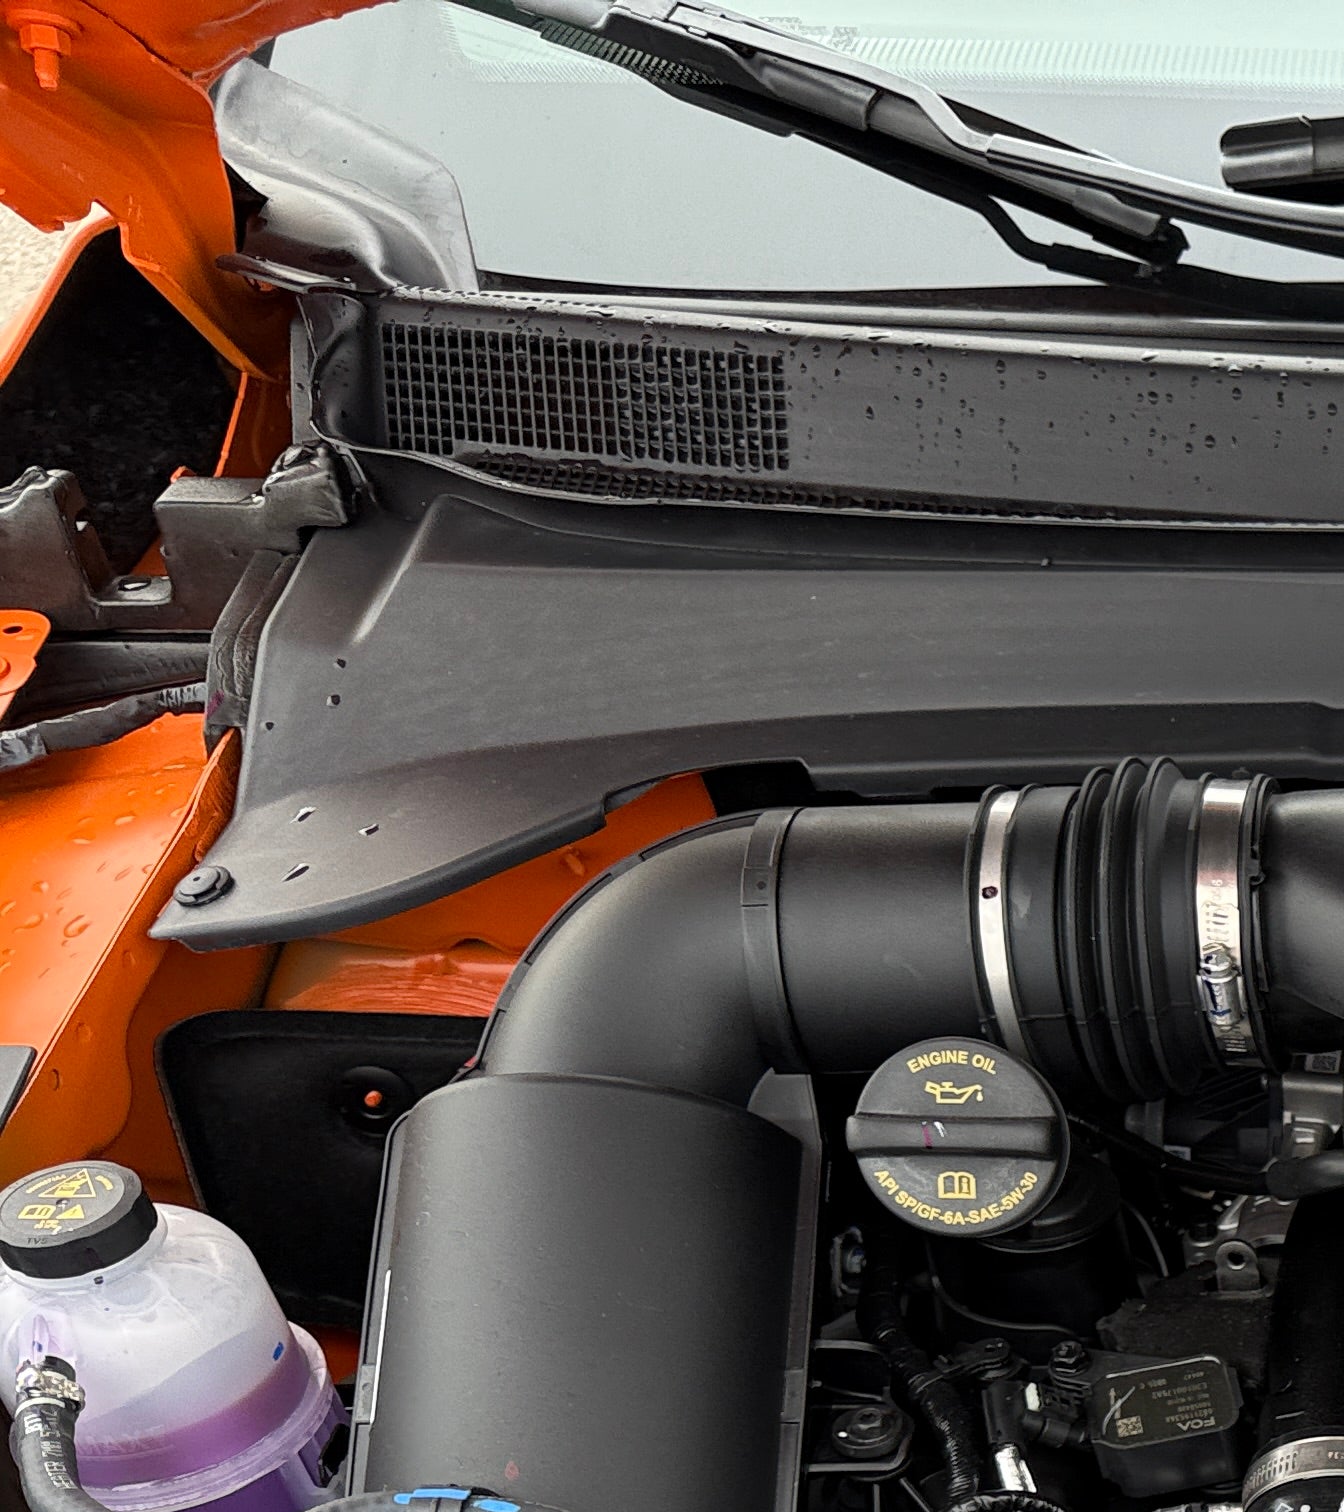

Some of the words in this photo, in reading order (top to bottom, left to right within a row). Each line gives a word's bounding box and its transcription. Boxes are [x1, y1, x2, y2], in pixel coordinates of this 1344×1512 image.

[906, 1050, 968, 1074] ENGINE
[971, 1053, 997, 1075] OIL
[874, 1170, 899, 1196] API
